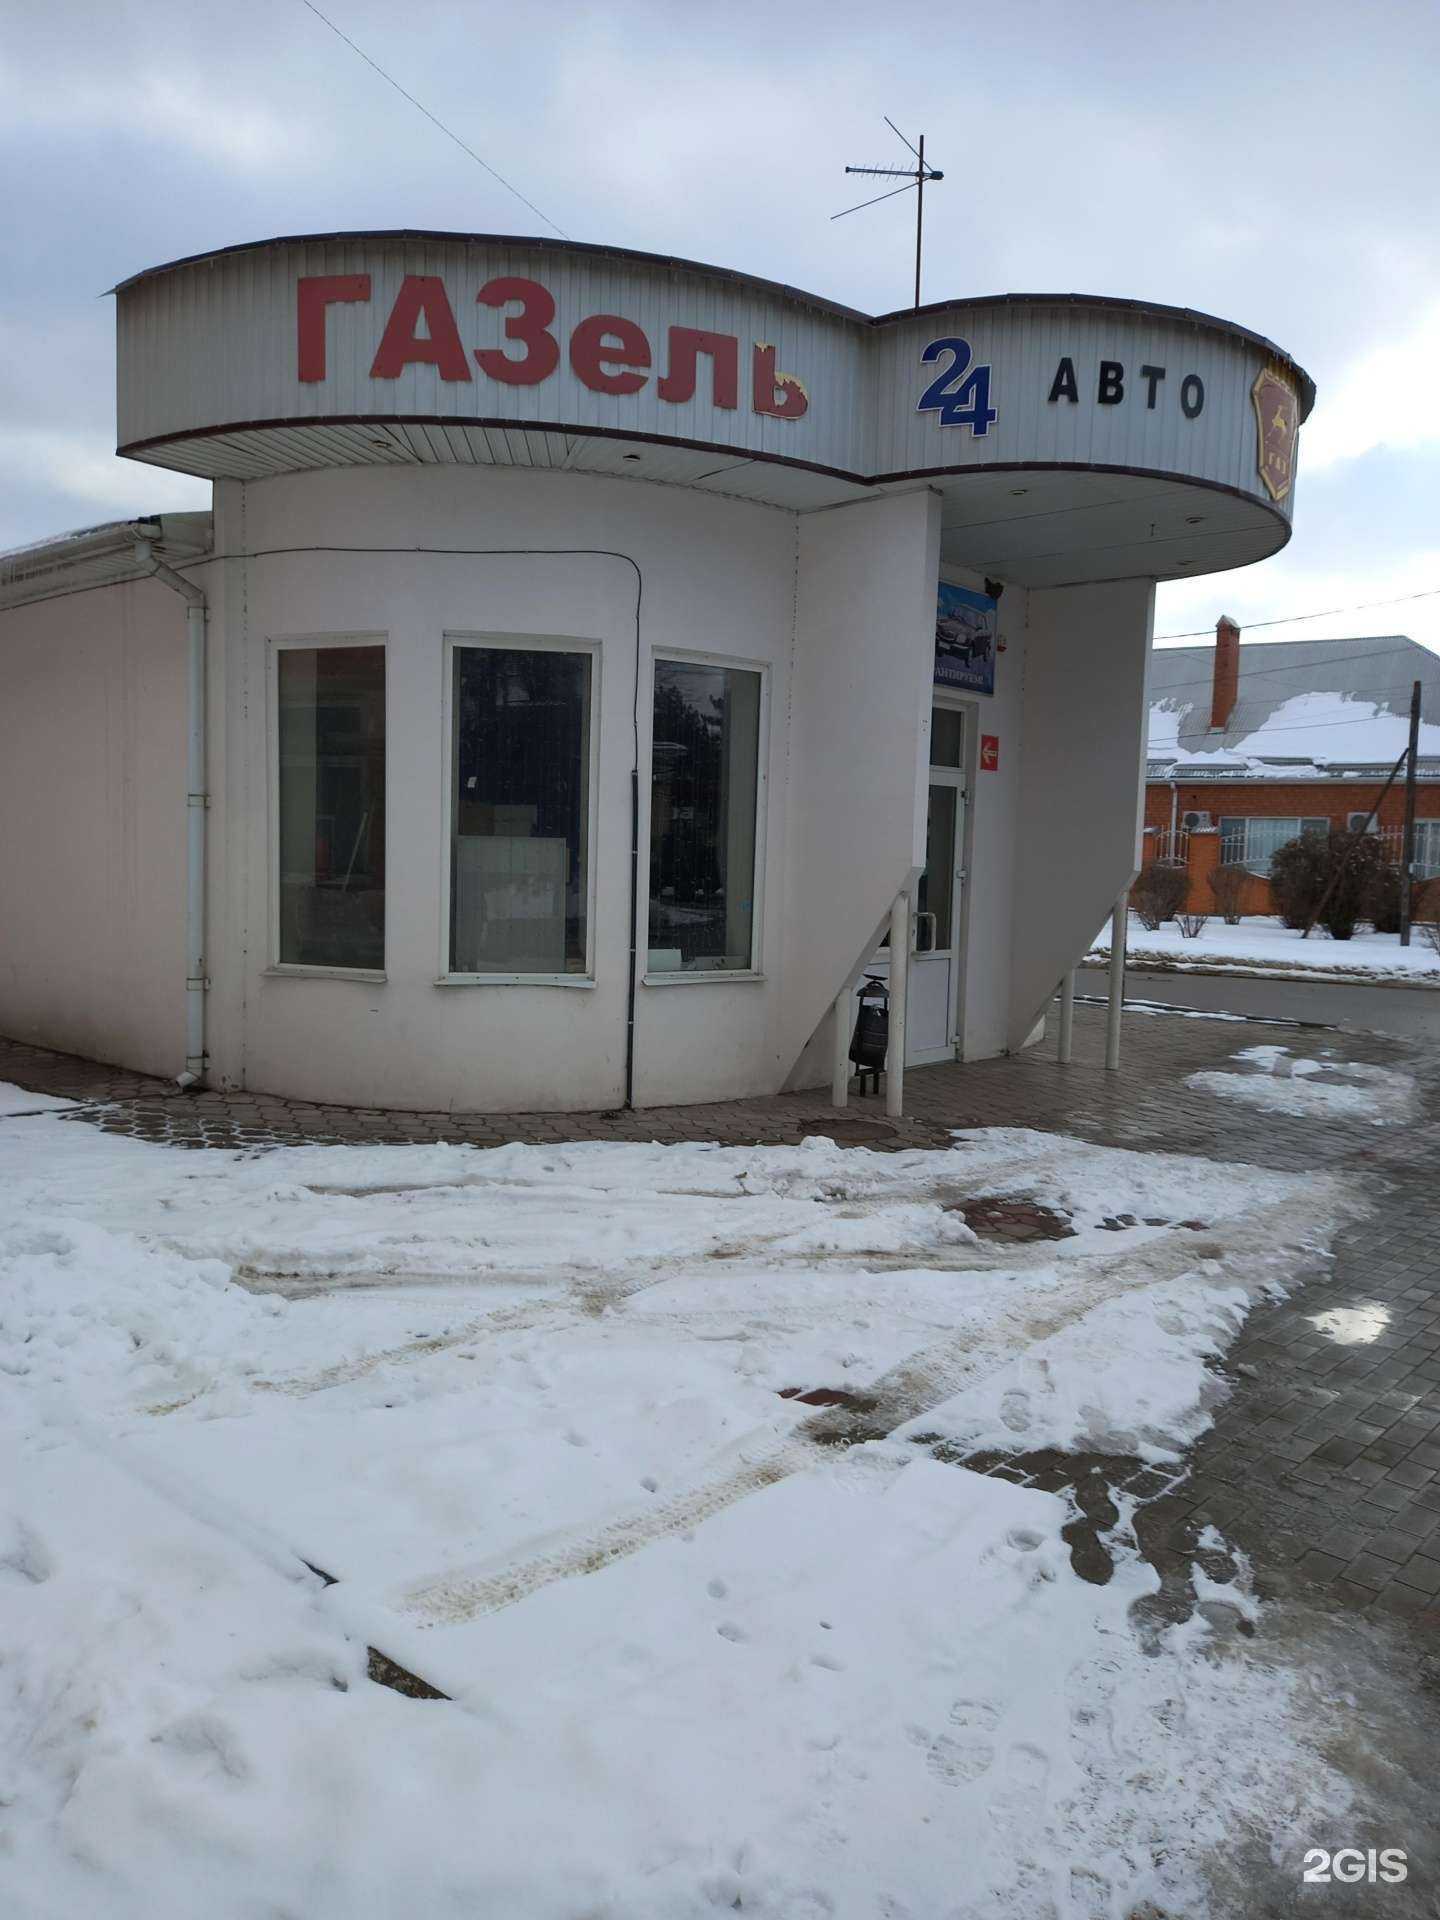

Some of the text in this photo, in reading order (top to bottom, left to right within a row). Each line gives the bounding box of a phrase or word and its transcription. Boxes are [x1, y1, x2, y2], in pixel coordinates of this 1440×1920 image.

[298, 274, 809, 420] ГАЗель
[916, 336, 1205, 437] 24 АВТО
